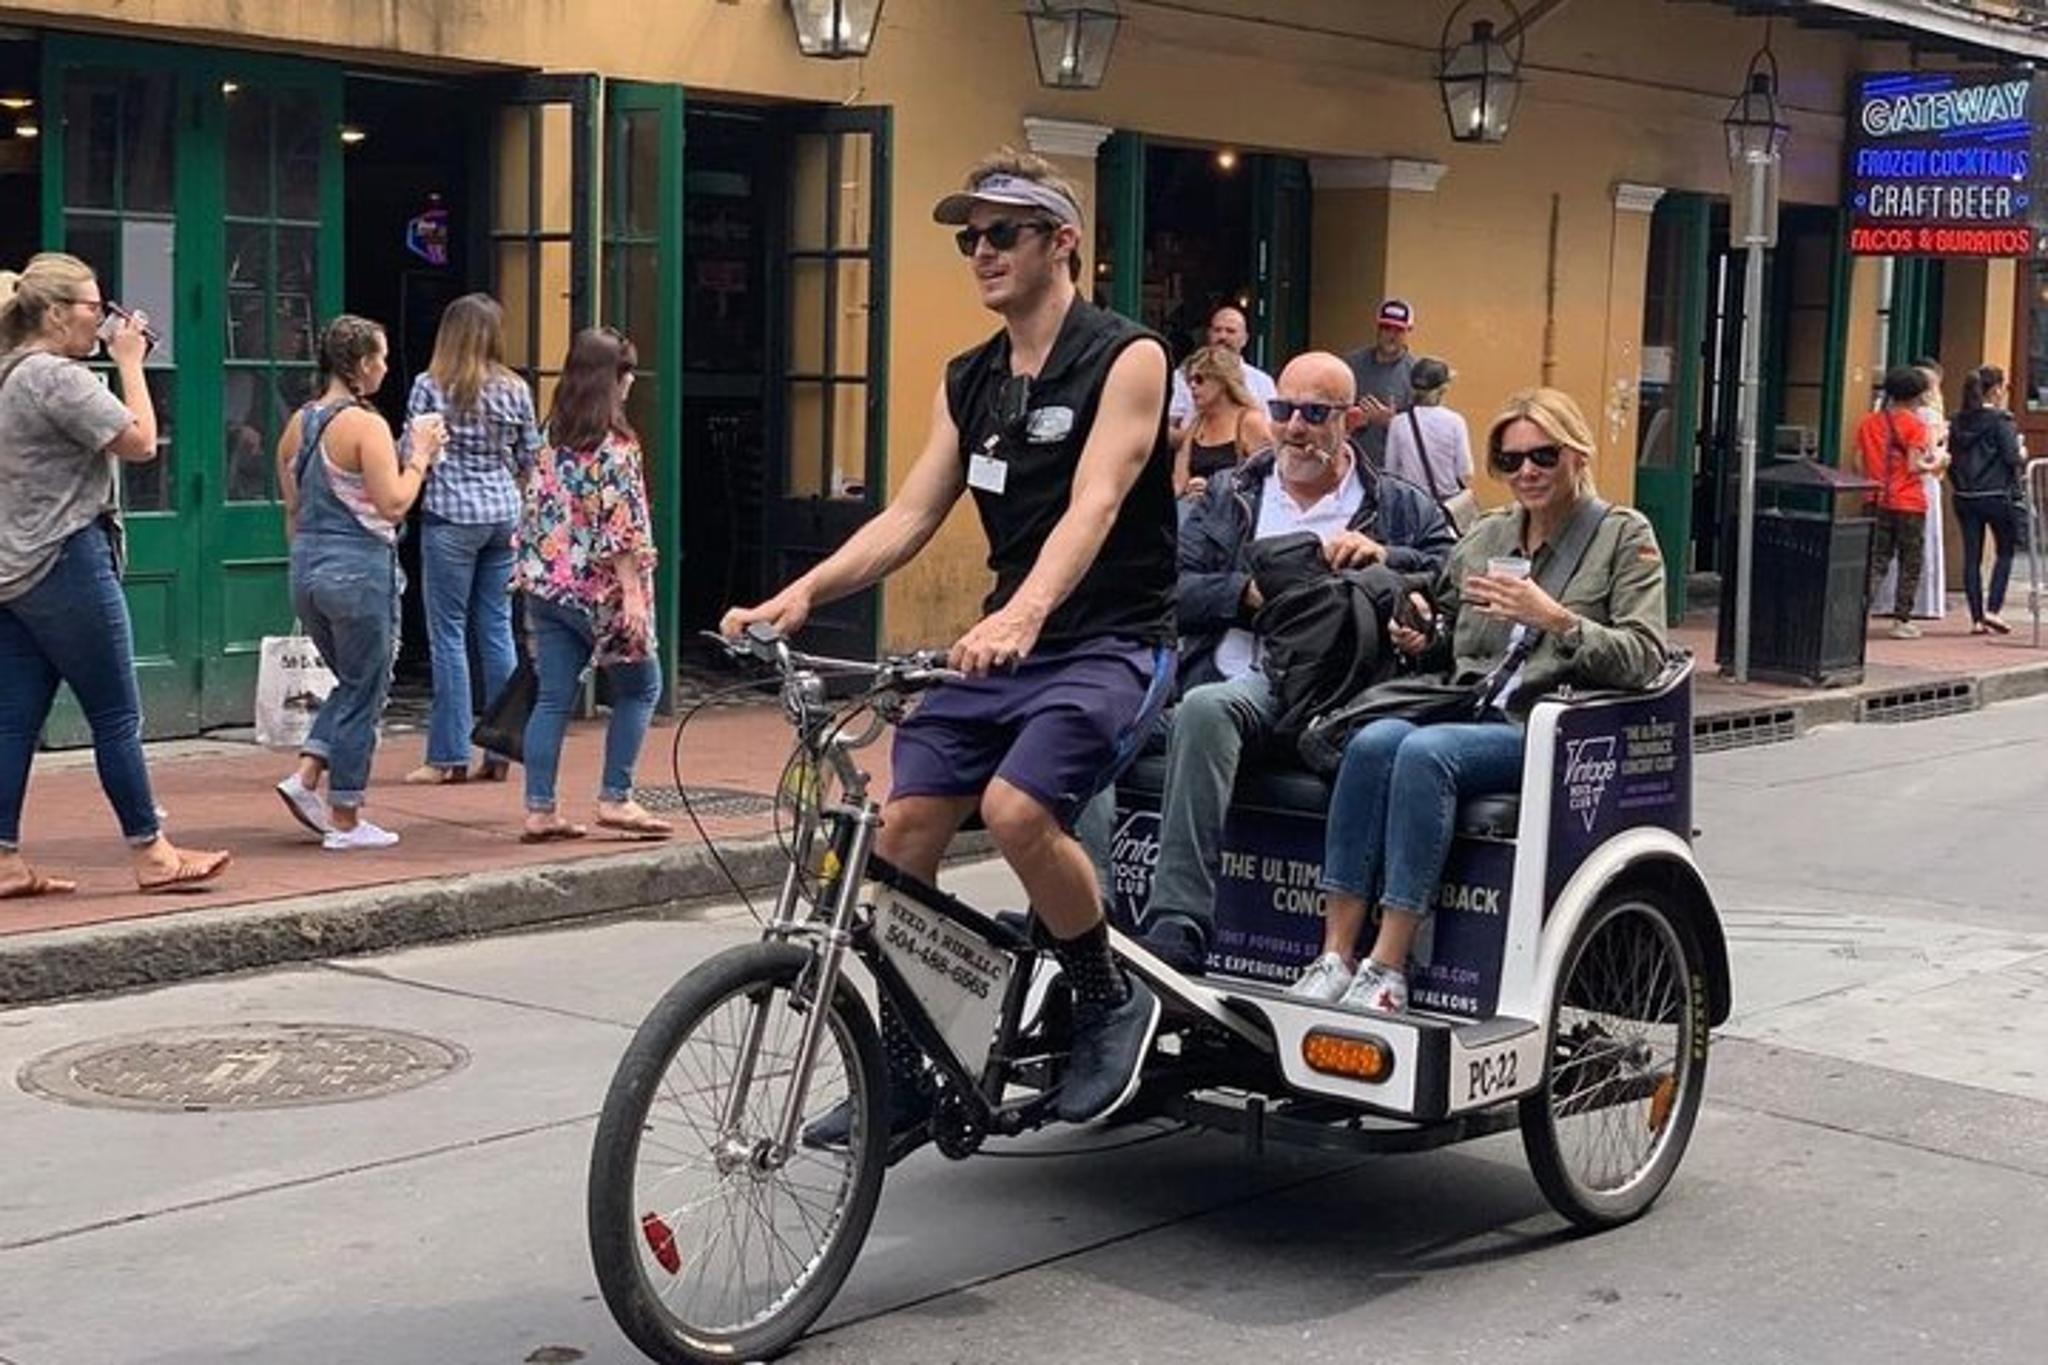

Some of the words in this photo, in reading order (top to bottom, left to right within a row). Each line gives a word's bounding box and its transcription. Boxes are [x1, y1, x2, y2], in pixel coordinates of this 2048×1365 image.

[1862, 80, 2030, 137] GATEWAY
[1857, 149, 1926, 177] FROZEN
[1930, 149, 2029, 178] COCKTAILS
[1869, 184, 1943, 218] CRAFT
[1950, 185, 2011, 219] BEER
[1852, 229, 1913, 251] TACOS
[1918, 228, 1933, 251] &
[1936, 229, 2030, 254] BURRITOS
[1116, 864, 1147, 880] OCK
[1220, 852, 1257, 880] THE
[1262, 857, 1323, 888] ULTIM
[1116, 878, 1147, 896] LUB
[927, 927, 939, 943] A
[1225, 955, 1301, 981] EXPERIENCE
[1467, 1050, 1519, 1101] PC-22
